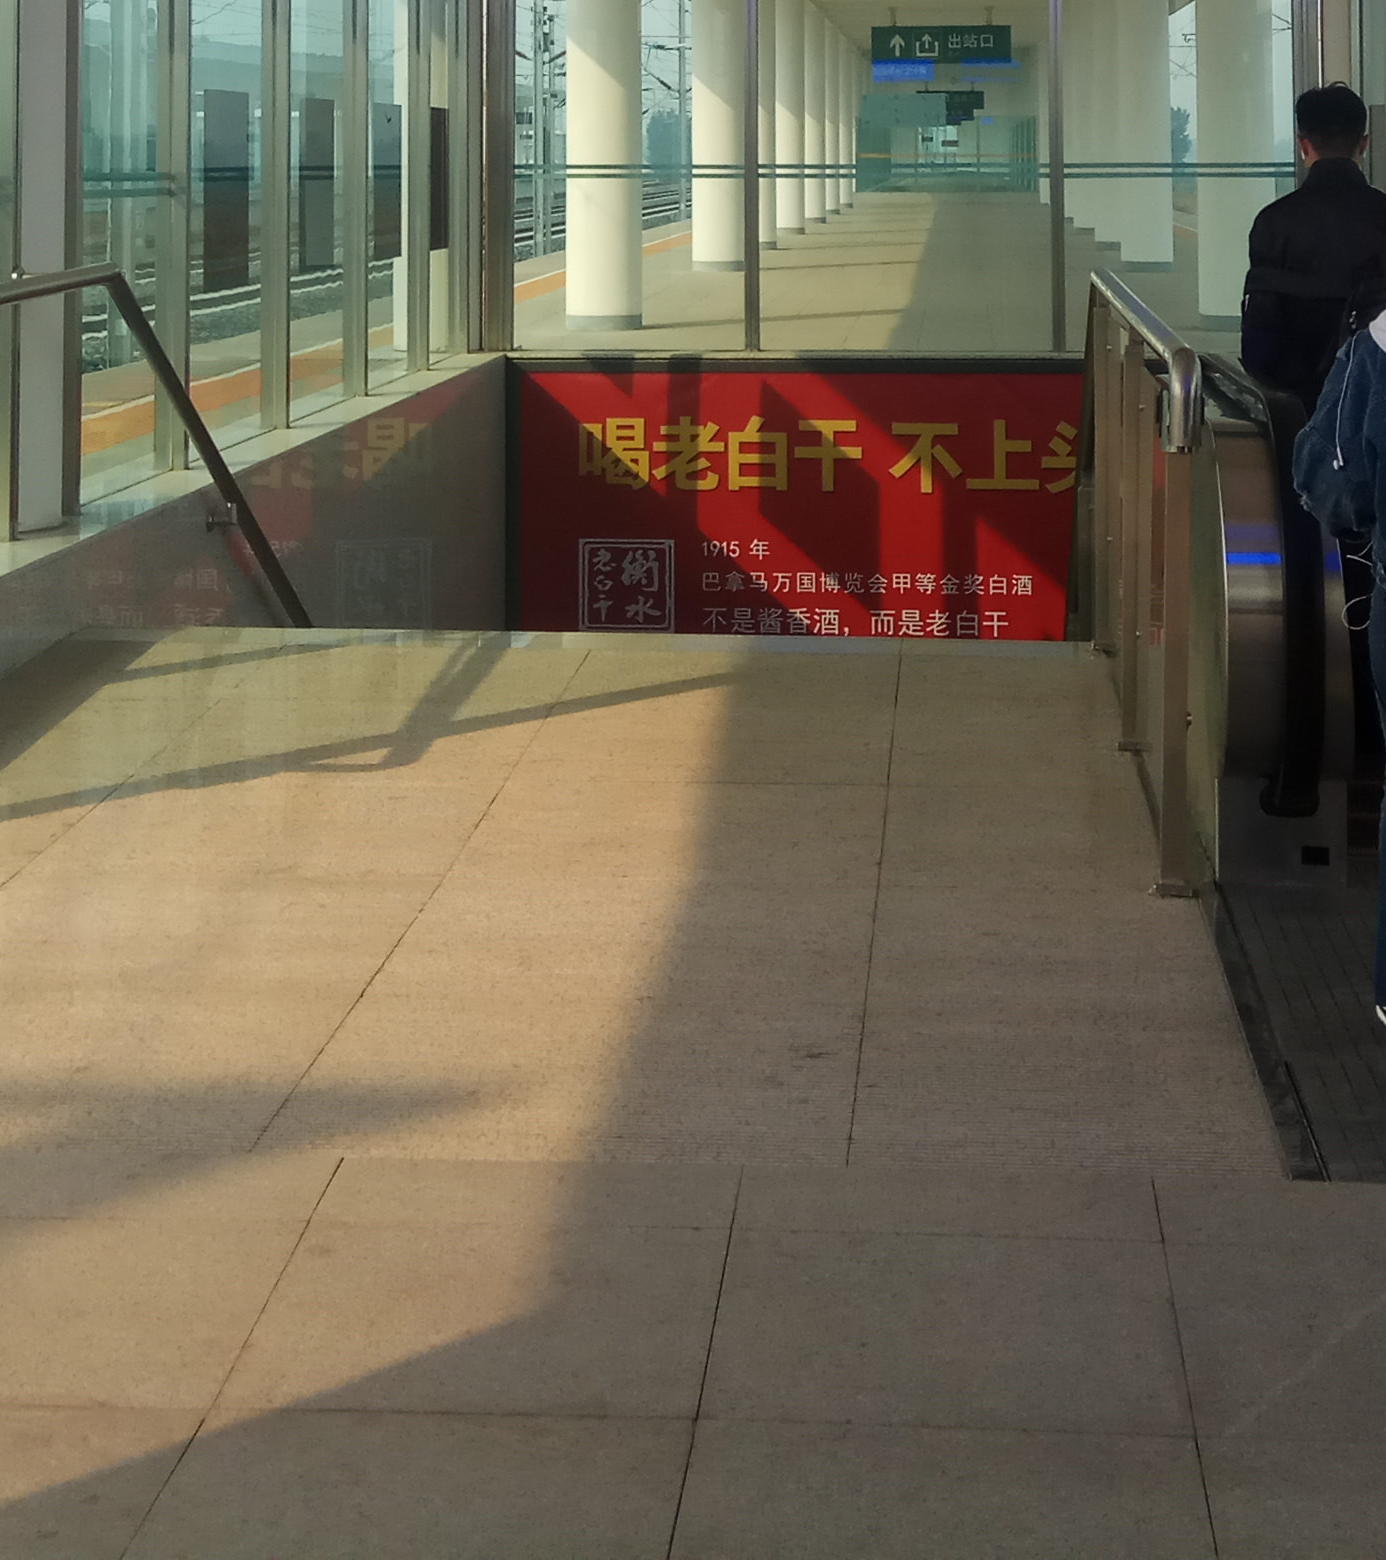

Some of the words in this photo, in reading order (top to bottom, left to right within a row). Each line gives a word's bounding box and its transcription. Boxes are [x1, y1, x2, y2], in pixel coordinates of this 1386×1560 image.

[947, 32, 994, 49] 出站口
[579, 414, 863, 494] 喝老白干
[701, 541, 740, 558] 1915
[749, 538, 771, 561] 年
[701, 570, 1033, 596] 巴拿马万国博览会甲等金奖白酒
